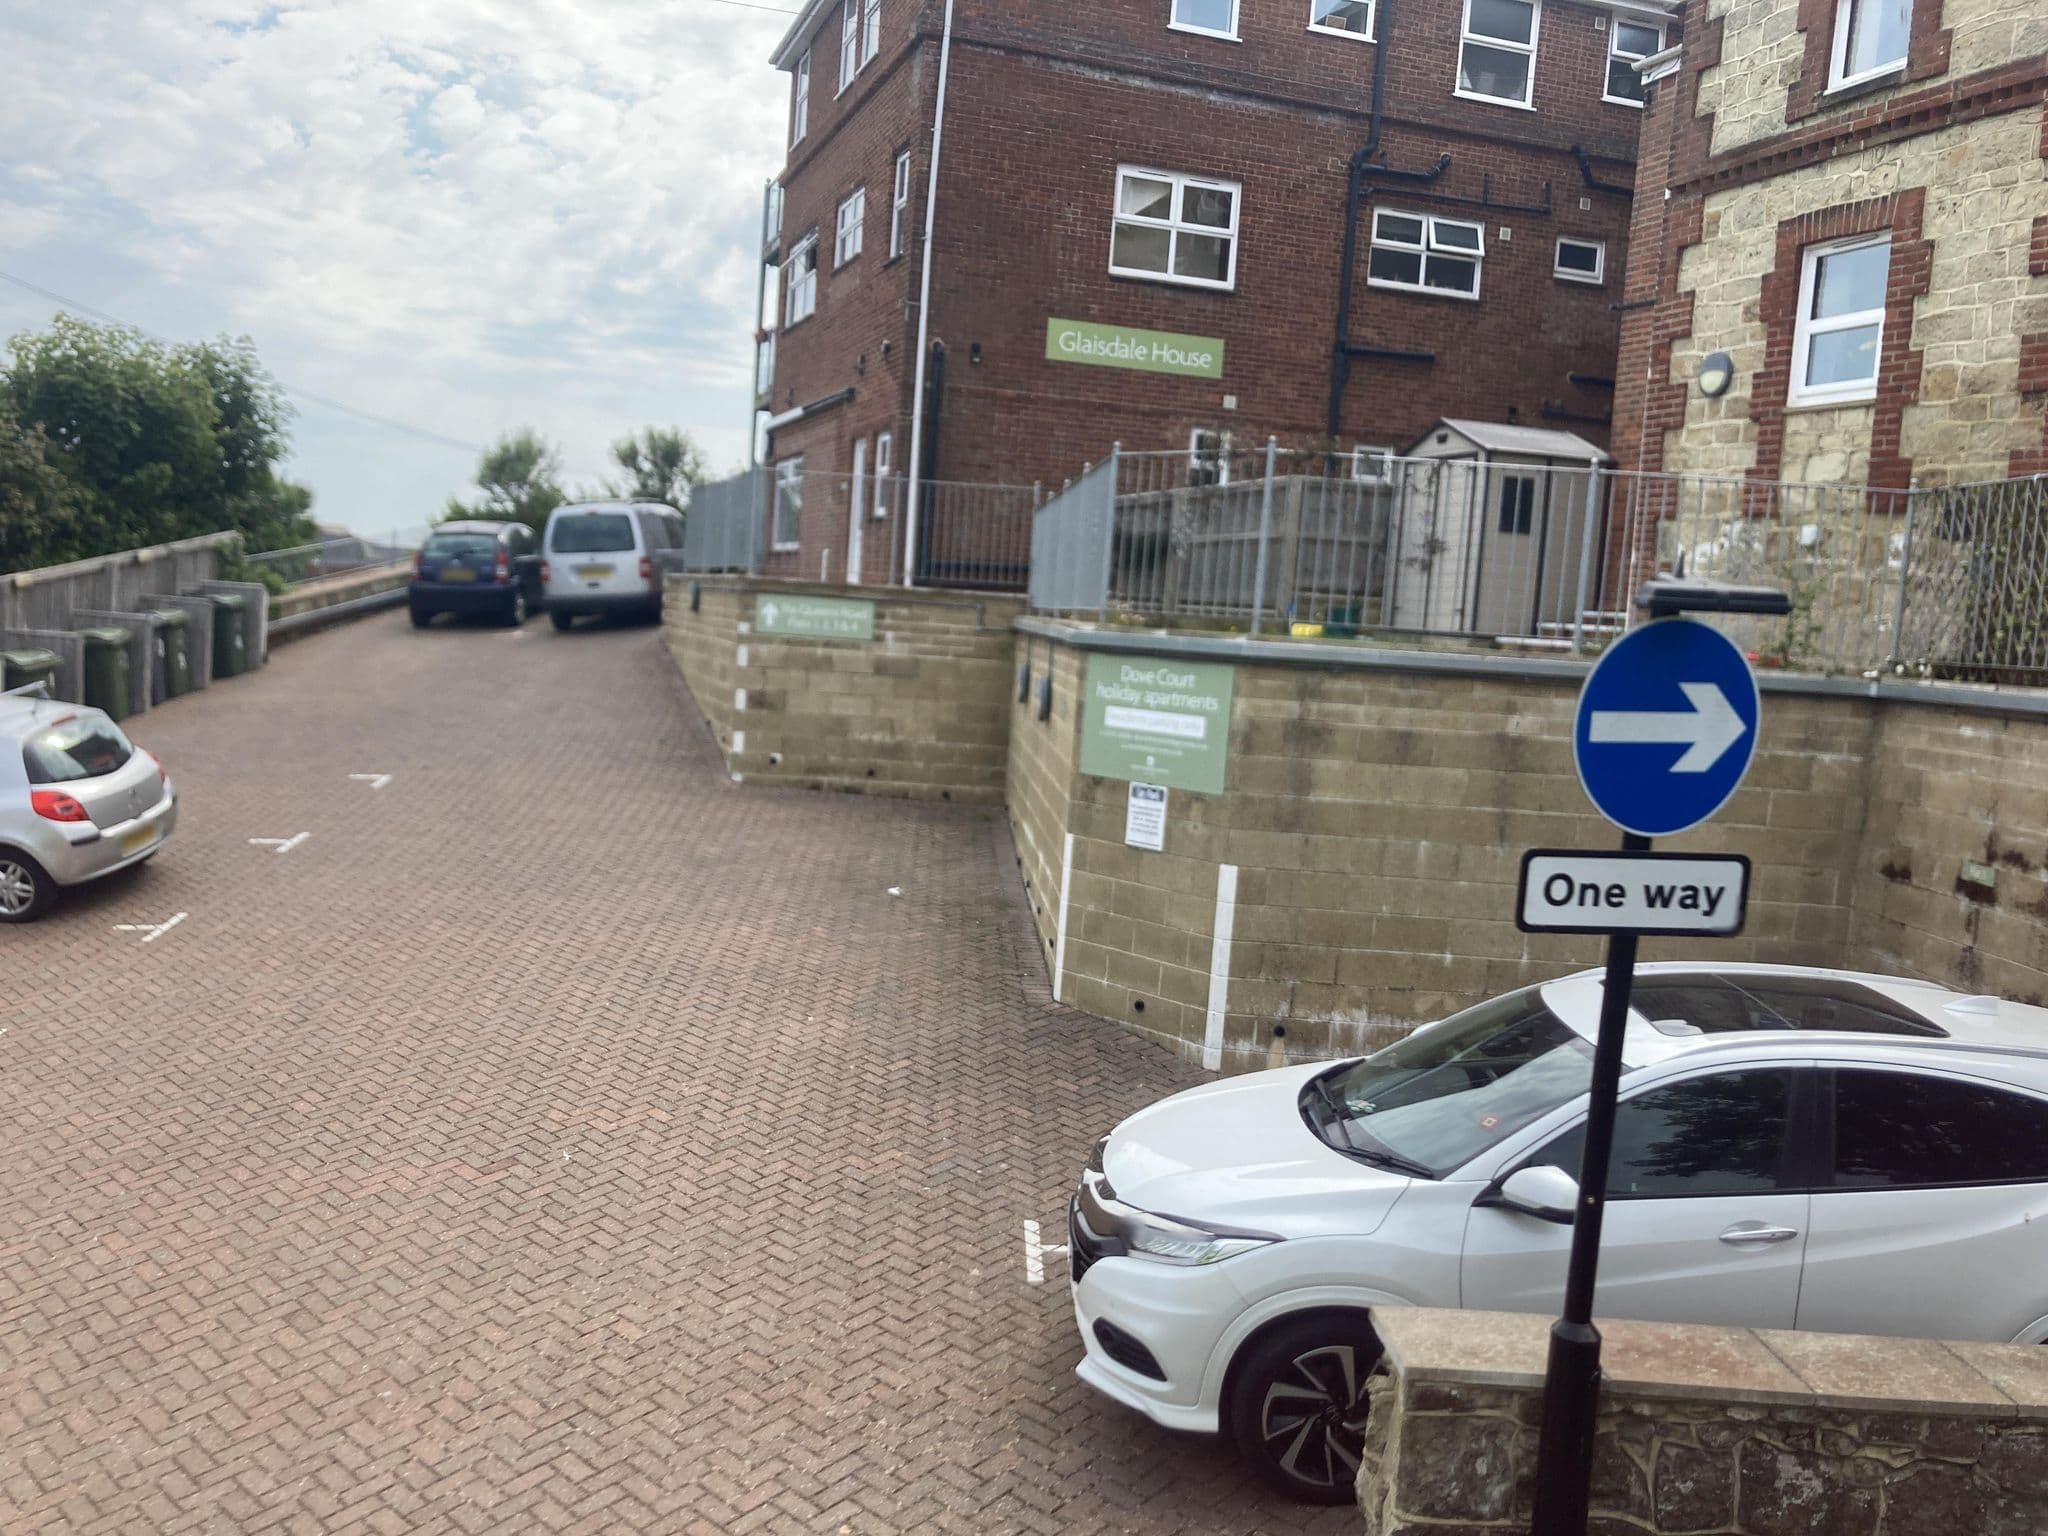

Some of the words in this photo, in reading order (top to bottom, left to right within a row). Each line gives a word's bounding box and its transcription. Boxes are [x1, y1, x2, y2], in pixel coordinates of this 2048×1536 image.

[1058, 331, 1147, 360] Glaisdale
[1151, 342, 1212, 368] House
[1156, 668, 1196, 688] Court
[1543, 872, 1627, 908] One
[1643, 884, 1726, 917] way
